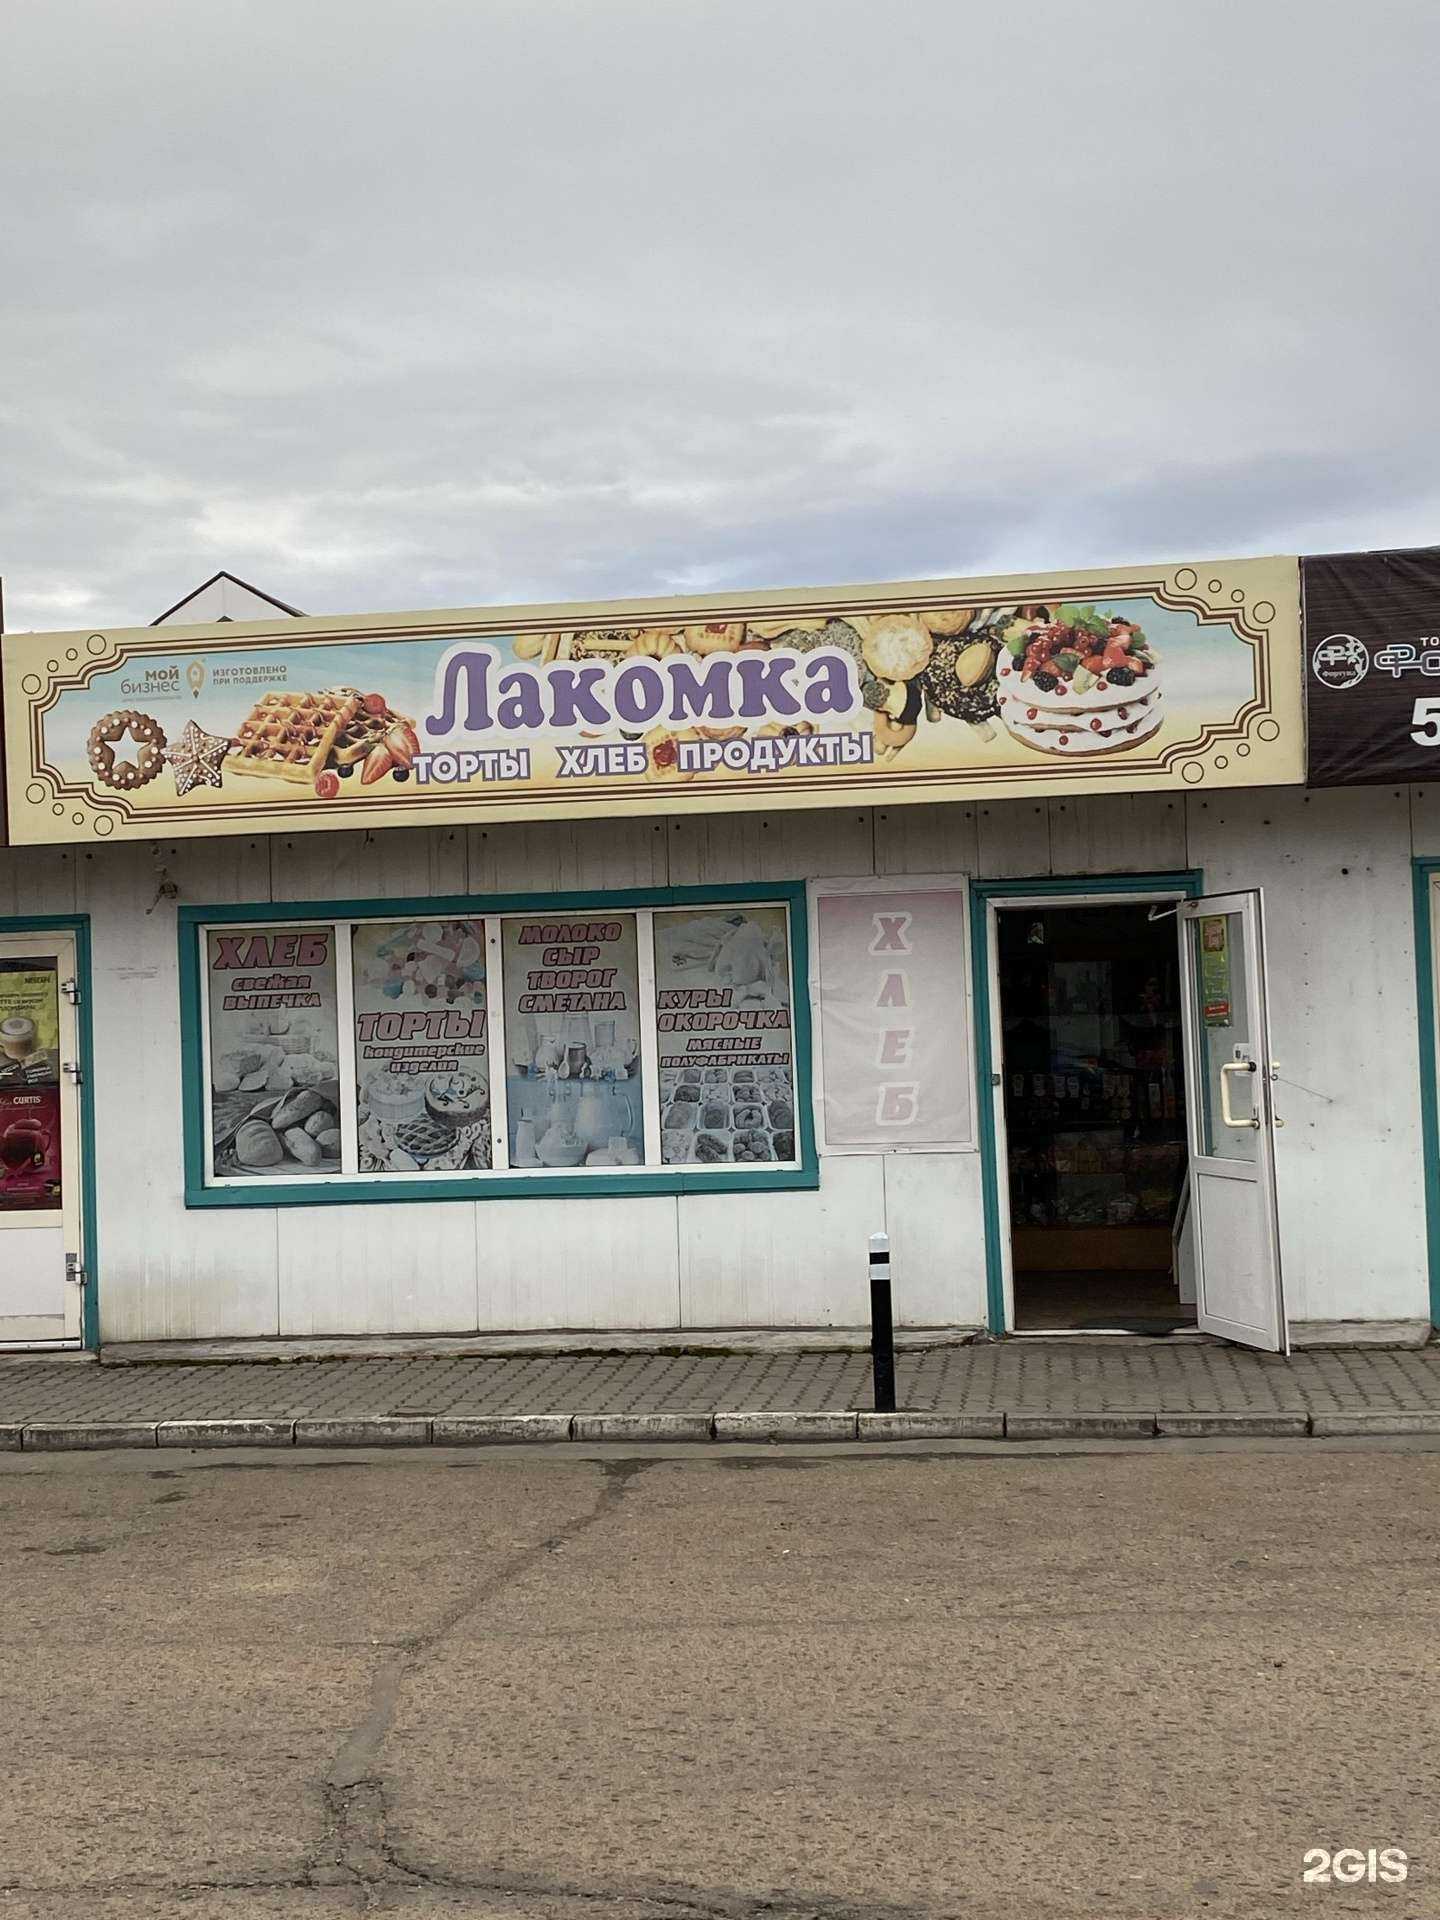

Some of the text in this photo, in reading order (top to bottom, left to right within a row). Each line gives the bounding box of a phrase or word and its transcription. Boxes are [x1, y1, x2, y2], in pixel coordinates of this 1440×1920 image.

[212, 665, 287, 677] ИЗГОТОВЛЕНО
[212, 674, 287, 685] ПРИ ПОДДЕРЖКЕ
[121, 679, 180, 694] бизнес
[425, 650, 855, 736] Лакомка
[412, 731, 874, 785] ТОРТЫ ХЛЕБ ПРОДУКТЫ
[518, 922, 622, 944] МОЛОКО
[213, 933, 329, 970] ХЛЕБ
[542, 946, 600, 966] СЫР
[527, 968, 617, 990] ТВОРОГ
[222, 992, 321, 1011] ВЫПЕЧКА
[518, 991, 627, 1013] СМЕТАНА
[658, 988, 733, 1009] КУРЫ
[357, 1009, 486, 1041] ТОРТЫ
[657, 1009, 791, 1032] ОКОРОЧКА
[868, 911, 921, 1127] ХЛЕБ
[686, 1036, 762, 1052] МЯСНЫЕ
[660, 1053, 790, 1068] ПОЛУФАБРИКАТЫ
[13, 1096, 41, 1105] CURTIS
